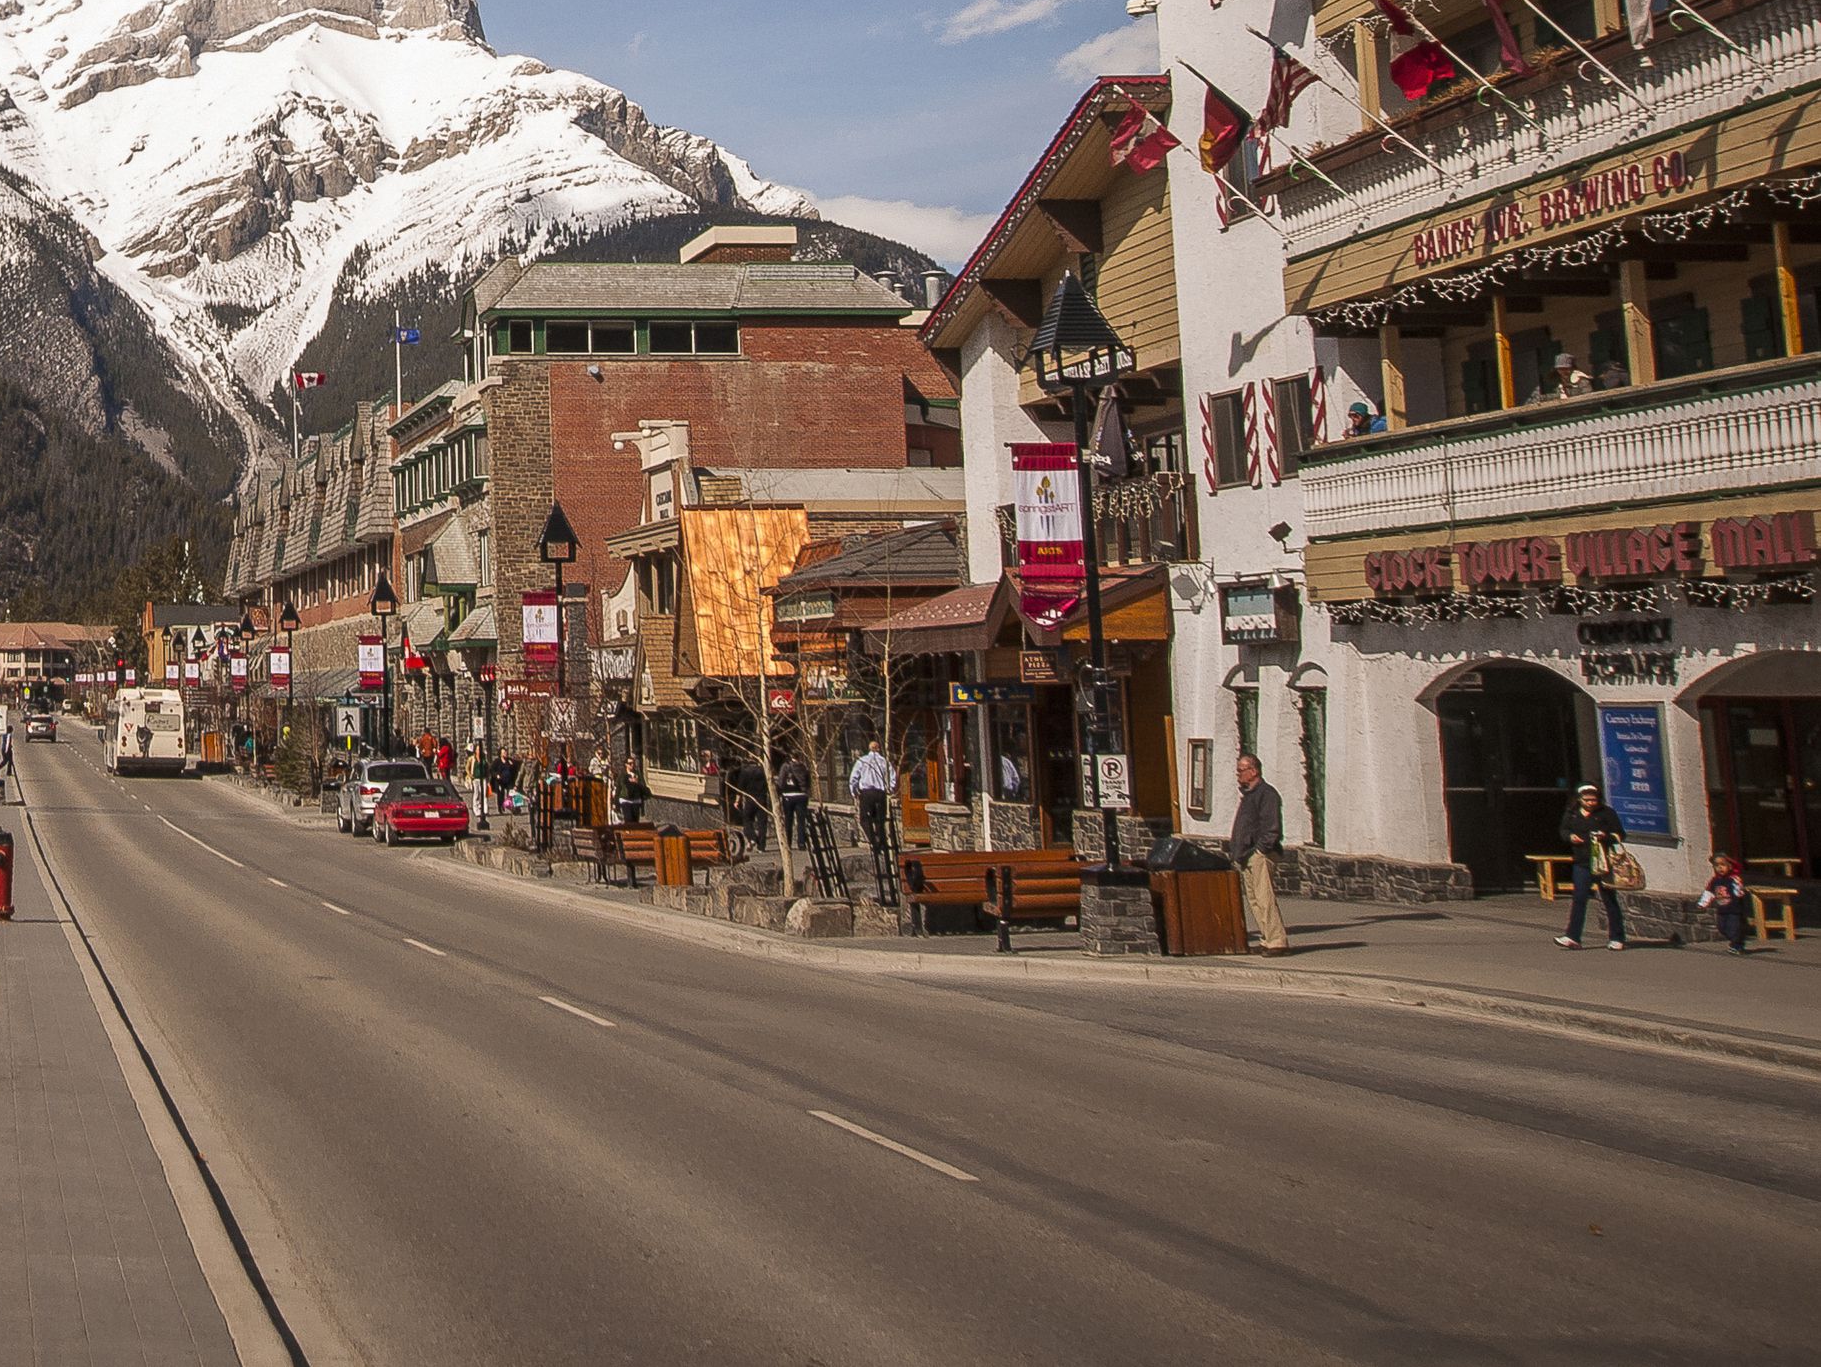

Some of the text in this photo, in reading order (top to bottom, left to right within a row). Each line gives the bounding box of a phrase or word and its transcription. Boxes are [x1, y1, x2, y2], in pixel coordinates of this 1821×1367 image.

[1413, 150, 1695, 265] BANFF AVE. BREWING CO.
[1364, 512, 1816, 592] CLOCK TOWER VILLAGE MALL
